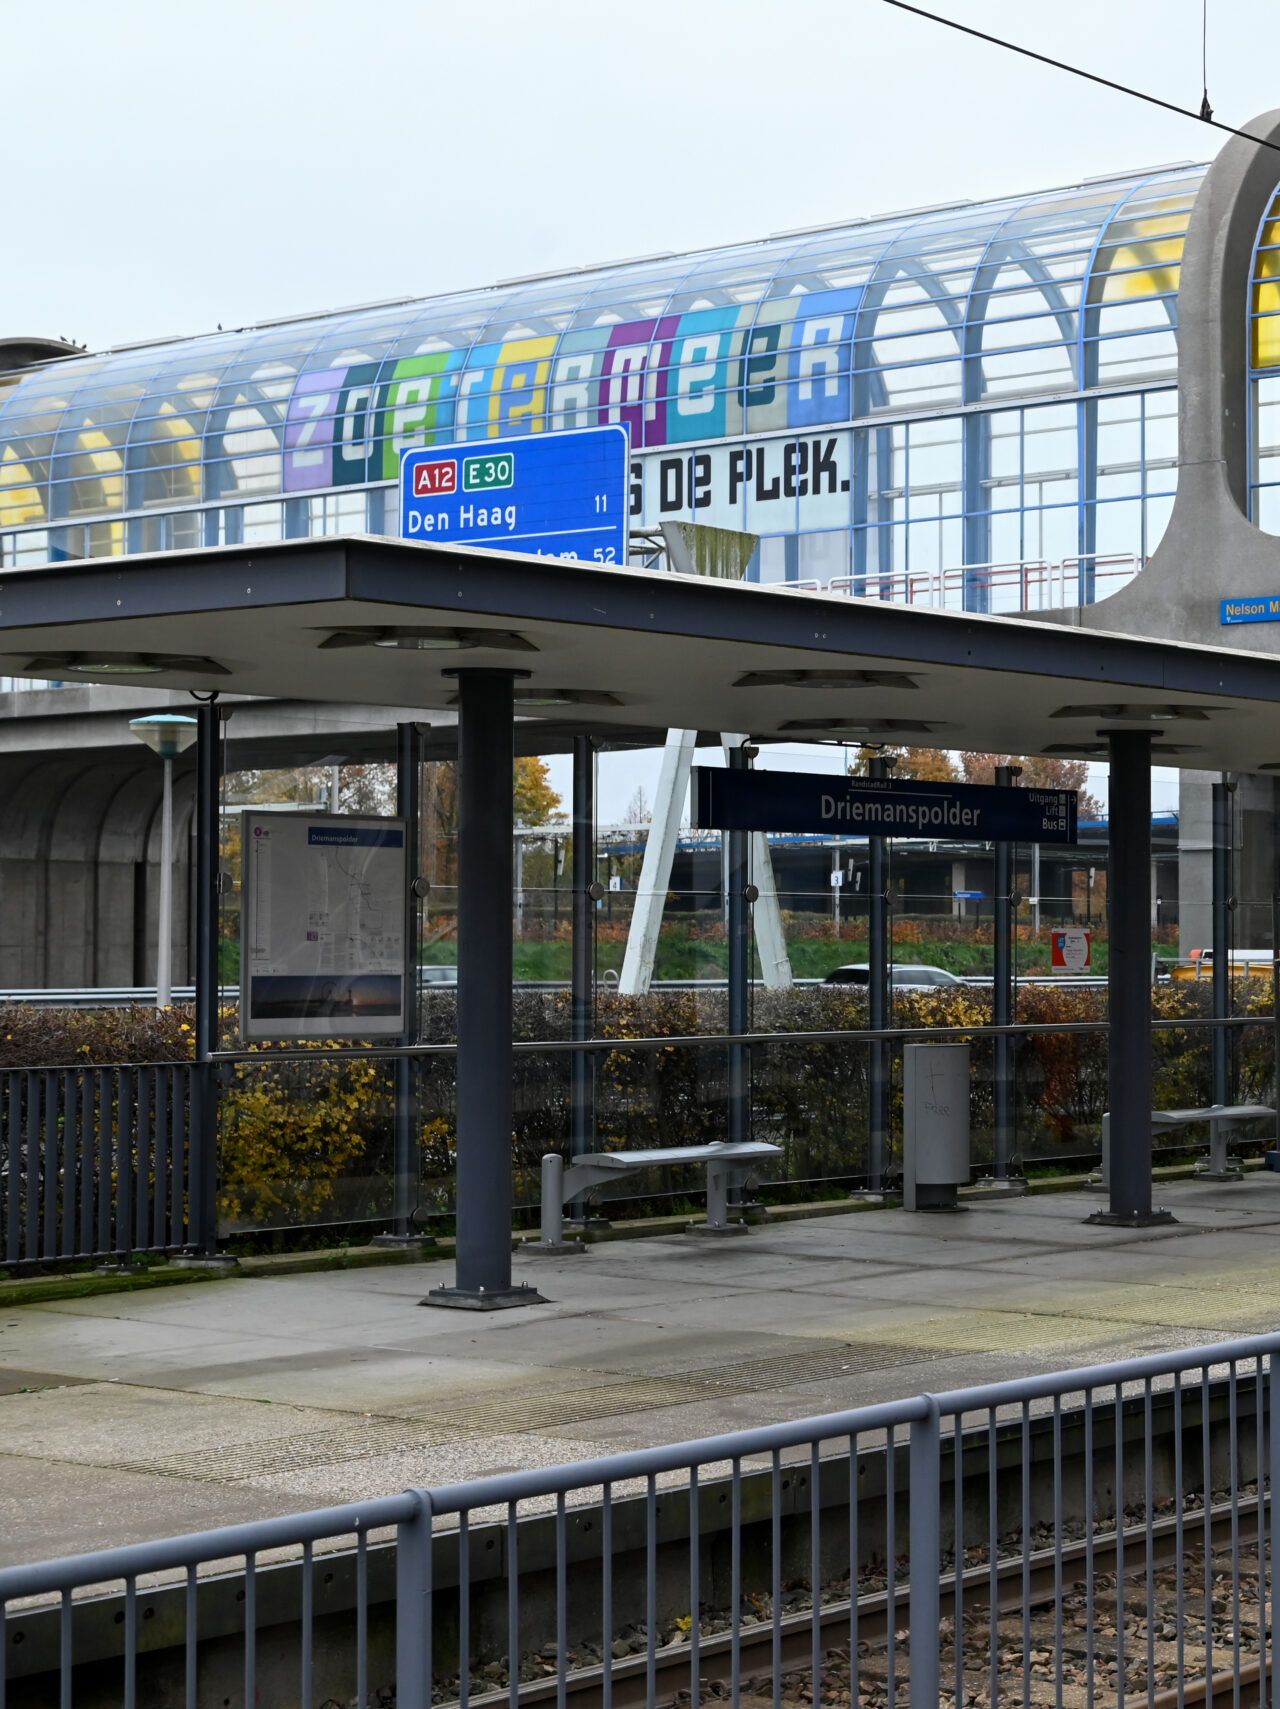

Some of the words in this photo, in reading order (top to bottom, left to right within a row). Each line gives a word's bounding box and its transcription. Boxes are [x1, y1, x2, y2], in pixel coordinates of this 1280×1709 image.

[418, 467, 453, 490] A12
[594, 494, 607, 513] 11
[408, 510, 449, 533] Den
[460, 504, 516, 531] Haag
[593, 546, 616, 566] 52
[1226, 603, 1265, 616] Nelson
[1028, 791, 1058, 805] Uitgang
[820, 794, 981, 829] Driemanspolder
[1045, 805, 1058, 816] Lift
[1042, 817, 1058, 830] Bus
[834, 875, 839, 885] 3
